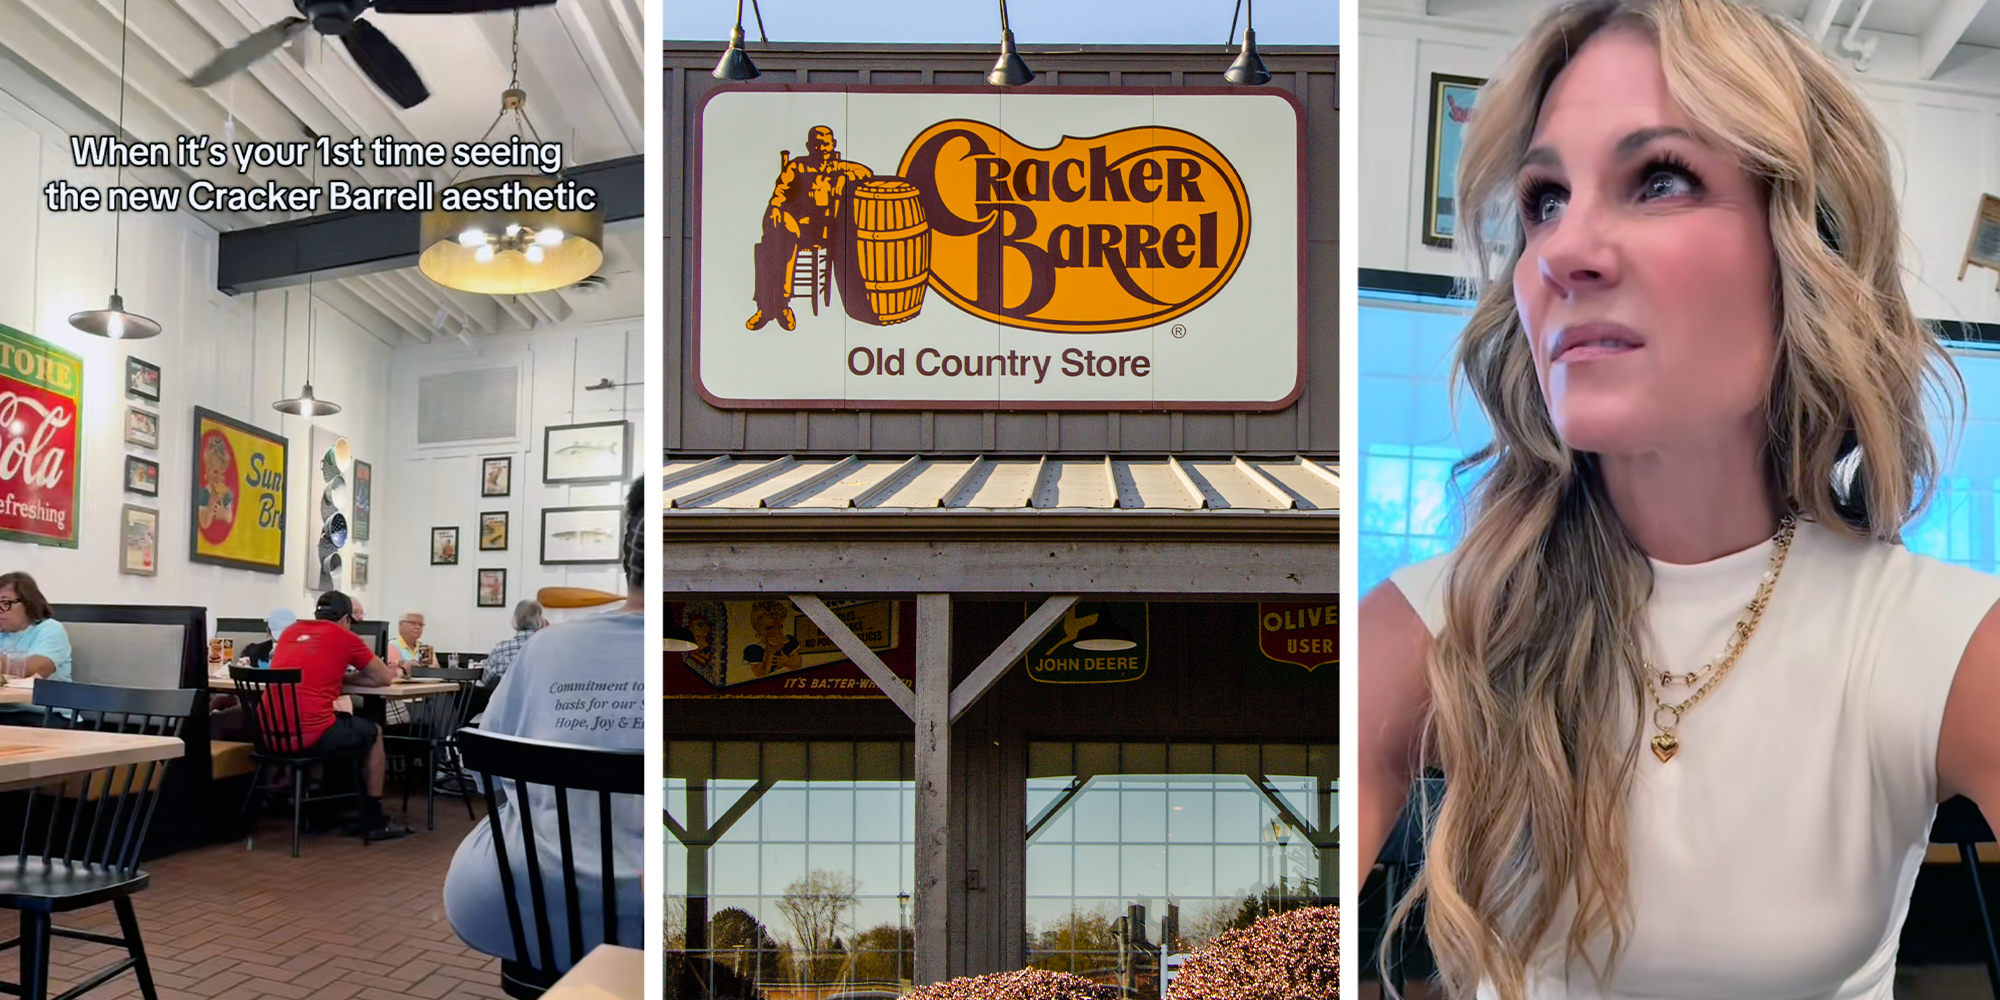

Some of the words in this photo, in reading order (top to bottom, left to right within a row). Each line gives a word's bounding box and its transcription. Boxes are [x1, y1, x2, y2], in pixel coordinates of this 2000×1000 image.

[974, 203, 1220, 318] Barrel
[847, 346, 905, 376] Old
[915, 347, 1052, 385] Country
[1061, 347, 1151, 377] Store
[1263, 605, 1338, 632] OLIVE
[1287, 638, 1333, 654] USER
[1035, 658, 1080, 672] JOHN
[1084, 657, 1139, 671] DEERE
[549, 680, 629, 694] Commitment
[632, 682, 644, 692] to
[784, 678, 808, 689] IT'S
[554, 699, 587, 711] basis
[586, 697, 609, 713] for
[611, 700, 637, 710] our
[554, 717, 589, 731] Hope,
[590, 716, 615, 731] Joy
[618, 716, 629, 729] &
